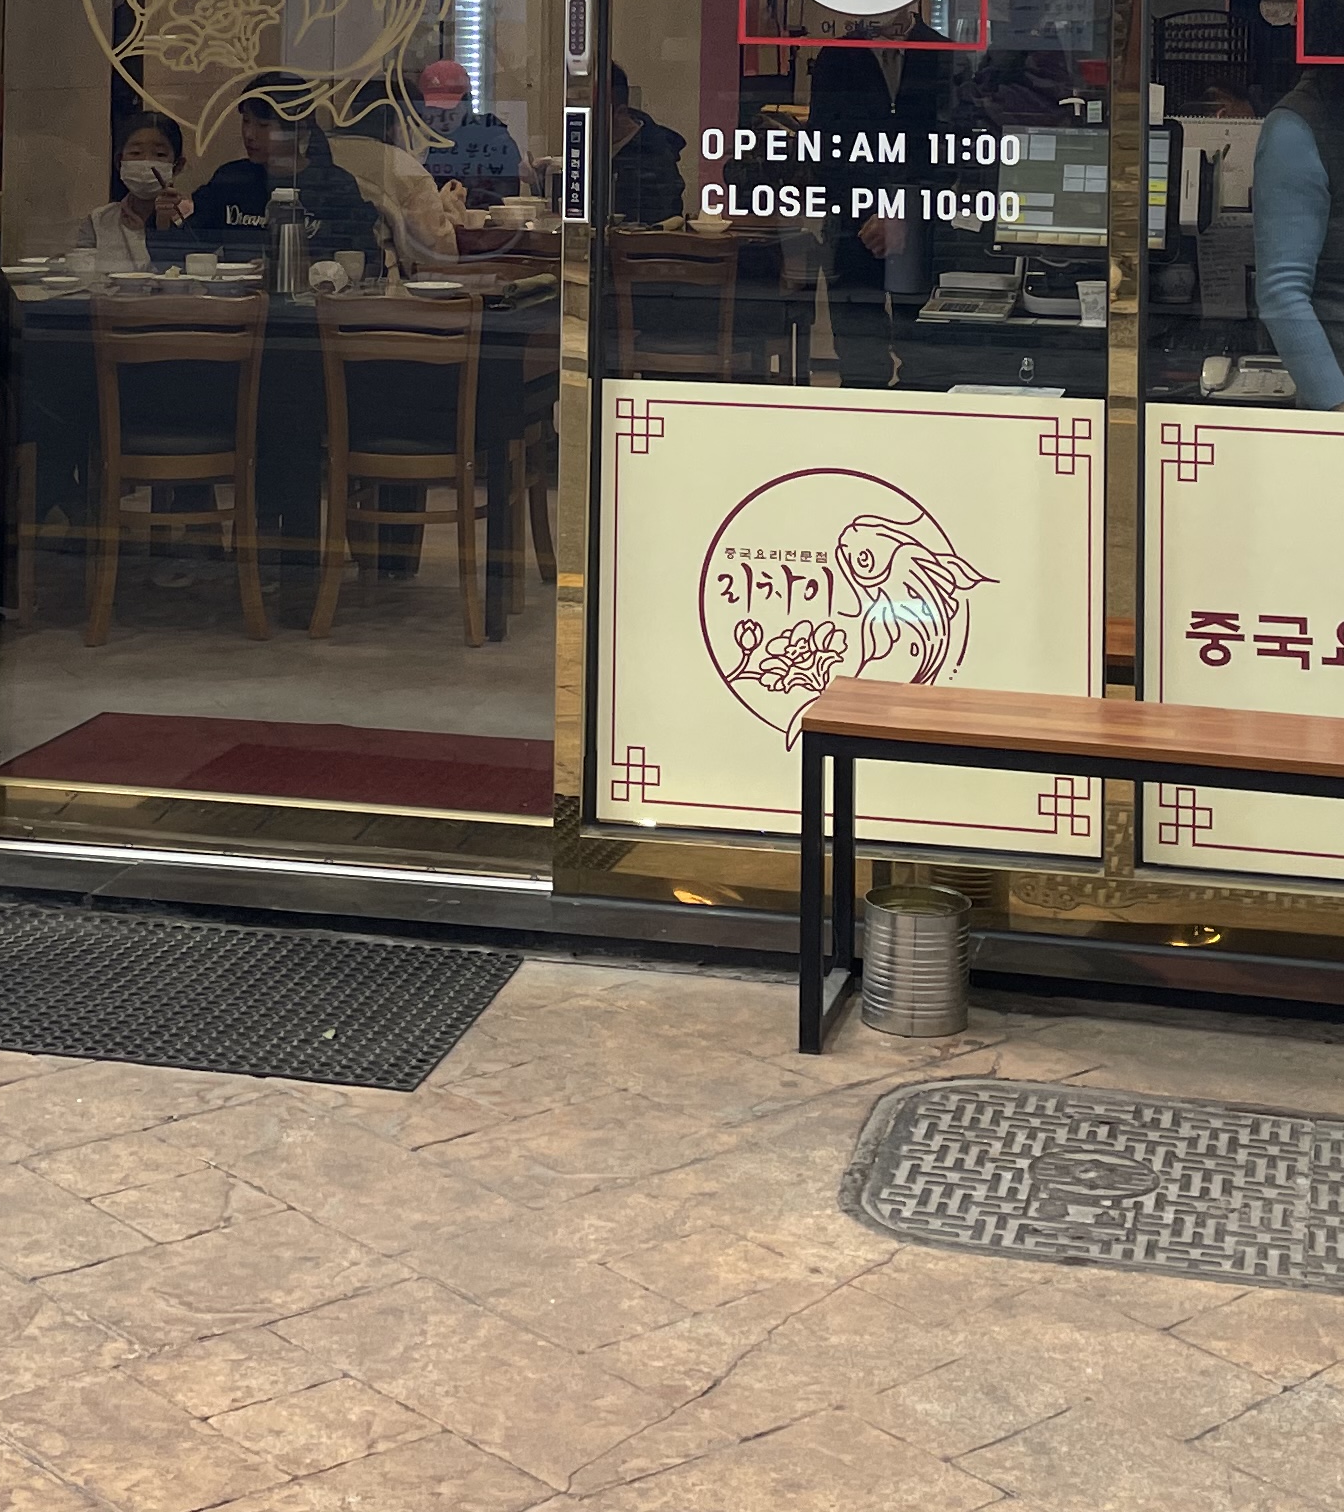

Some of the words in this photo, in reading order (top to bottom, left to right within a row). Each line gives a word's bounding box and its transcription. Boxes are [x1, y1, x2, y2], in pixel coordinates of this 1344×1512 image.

[927, 133, 1021, 166] 11:00
[920, 189, 1021, 223] 10:00
[723, 546, 830, 563] 중국요리전문점
[717, 564, 835, 617] 리차이
